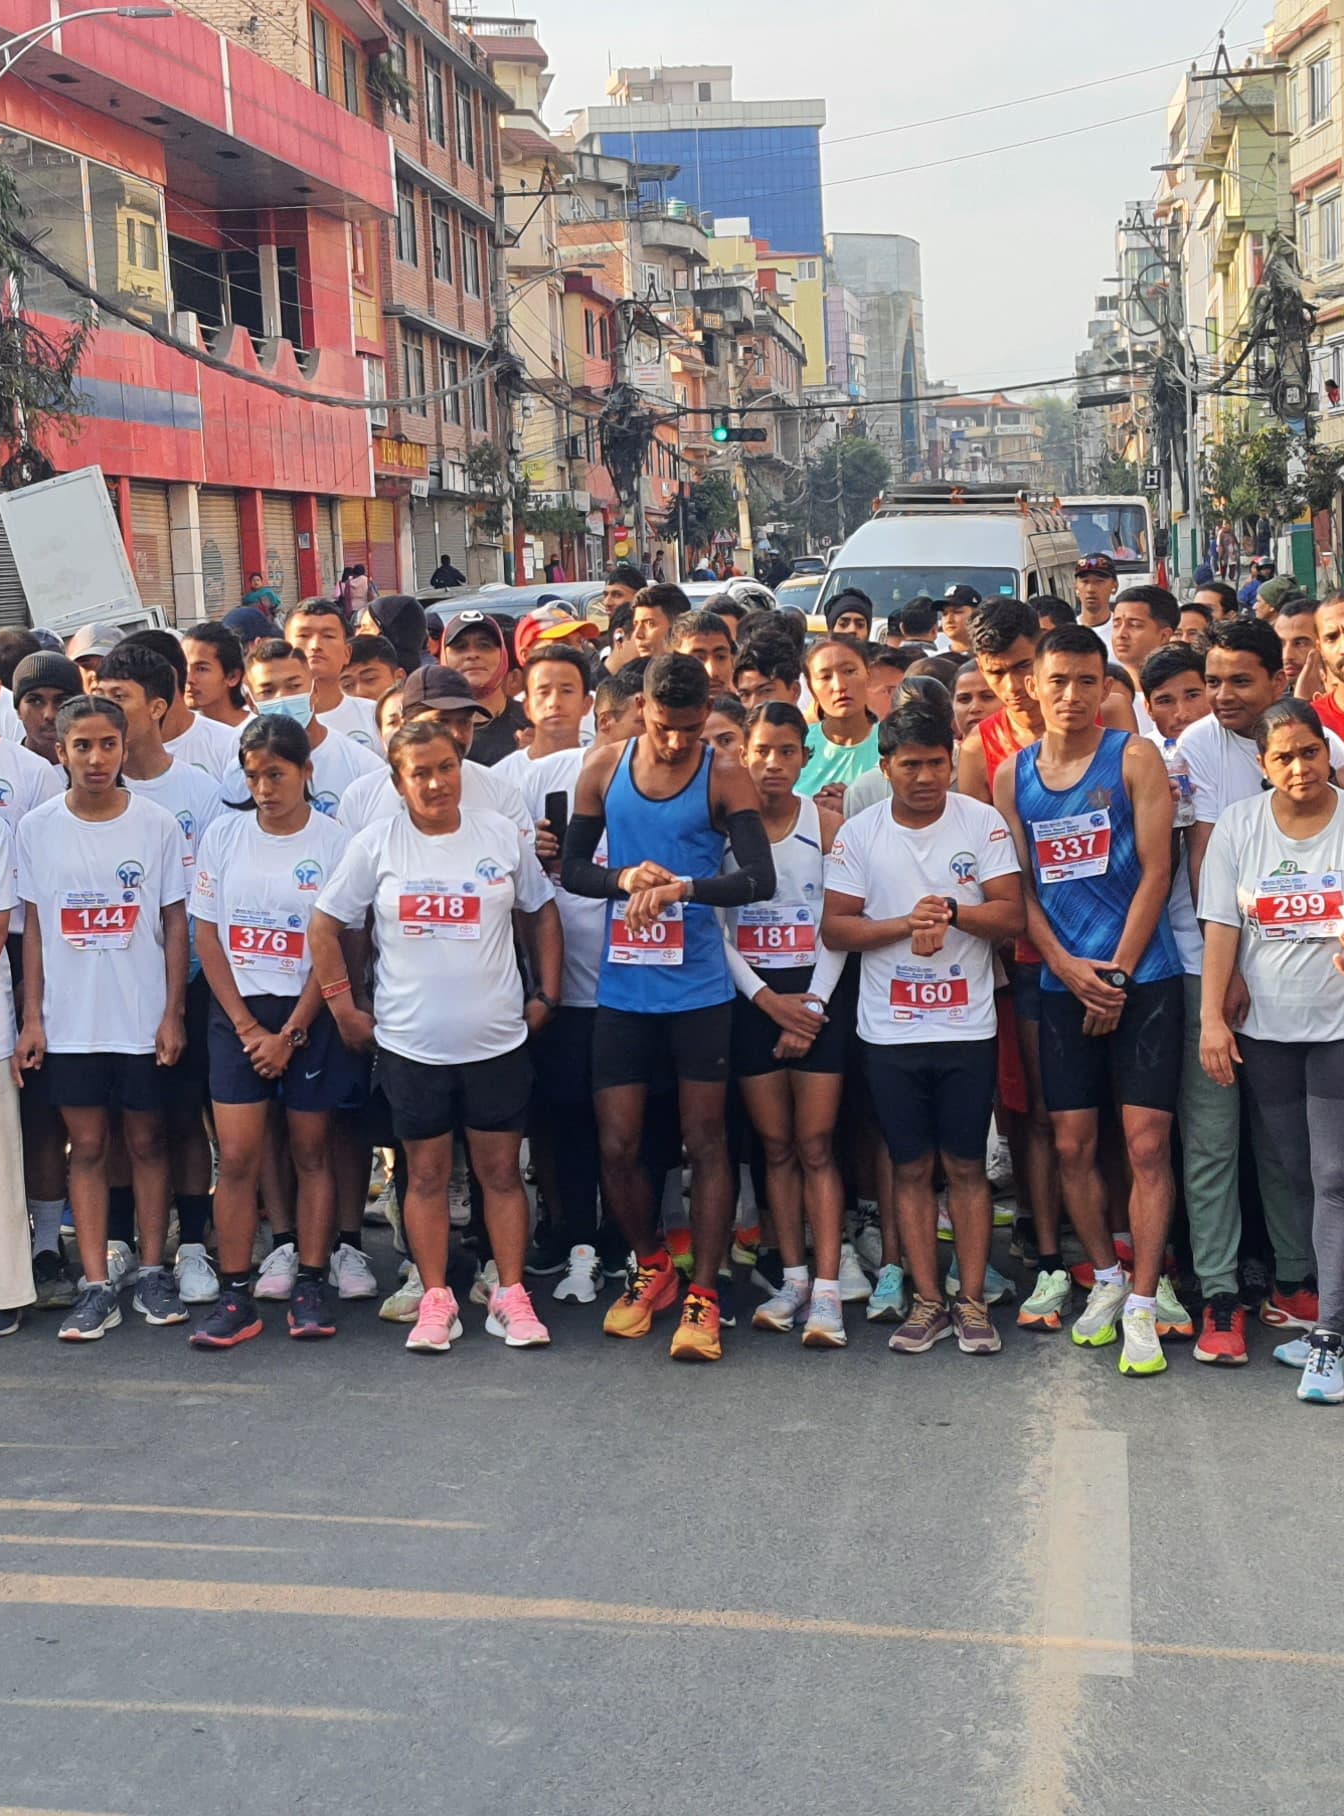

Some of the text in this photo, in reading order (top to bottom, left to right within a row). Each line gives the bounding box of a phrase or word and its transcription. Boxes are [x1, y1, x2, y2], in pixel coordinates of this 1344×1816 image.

[1050, 834, 1096, 861] 337
[415, 895, 465, 918] 218
[1272, 894, 1326, 918] 299
[77, 908, 126, 929] 144
[239, 927, 288, 952] 376
[753, 926, 796, 948] 181
[906, 982, 953, 1004] 160
